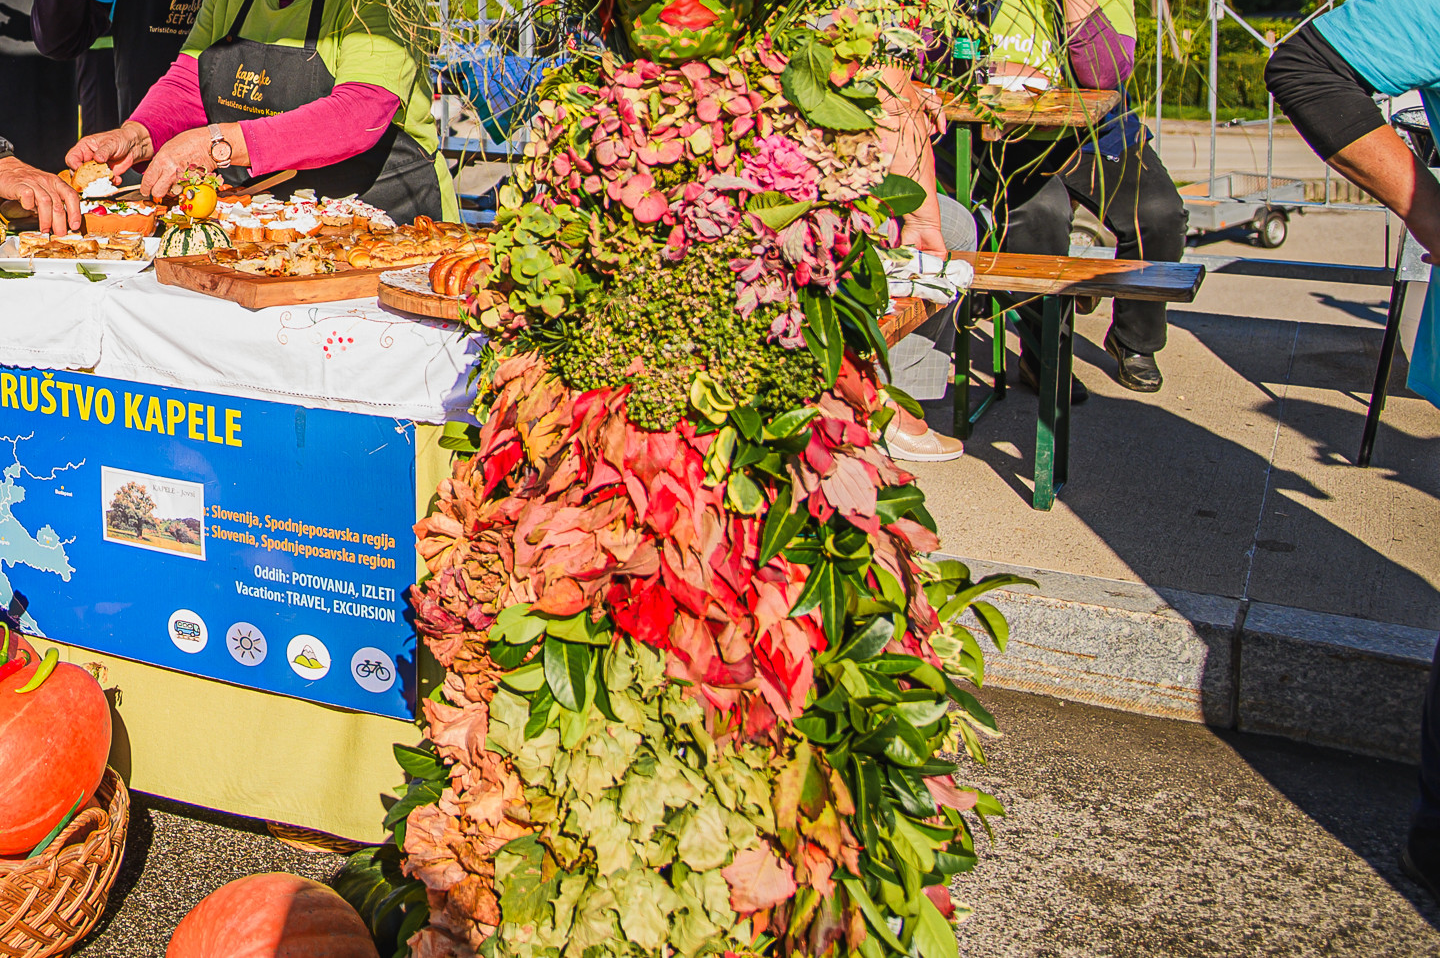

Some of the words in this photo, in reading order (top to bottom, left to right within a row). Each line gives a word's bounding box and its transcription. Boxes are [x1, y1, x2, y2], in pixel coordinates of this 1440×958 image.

[149, 25, 177, 35] Turistično
[124, 392, 242, 447] KAPELE
[152, 484, 176, 494] KAPELE
[211, 505, 262, 529] Slovenija,
[265, 515, 360, 543] Spodnjeposavska
[362, 533, 396, 551] regija
[211, 525, 259, 548] Slovenia,
[261, 535, 356, 563] Spodnjeposavska
[358, 554, 396, 570] region
[235, 580, 285, 603] Vacation:
[286, 591, 331, 613] TRAVEL,
[333, 600, 396, 623] EXCURSION
[254, 565, 290, 584] Oddih:
[292, 572, 360, 598] POTOVANJA,
[362, 584, 396, 602] IZLETI
